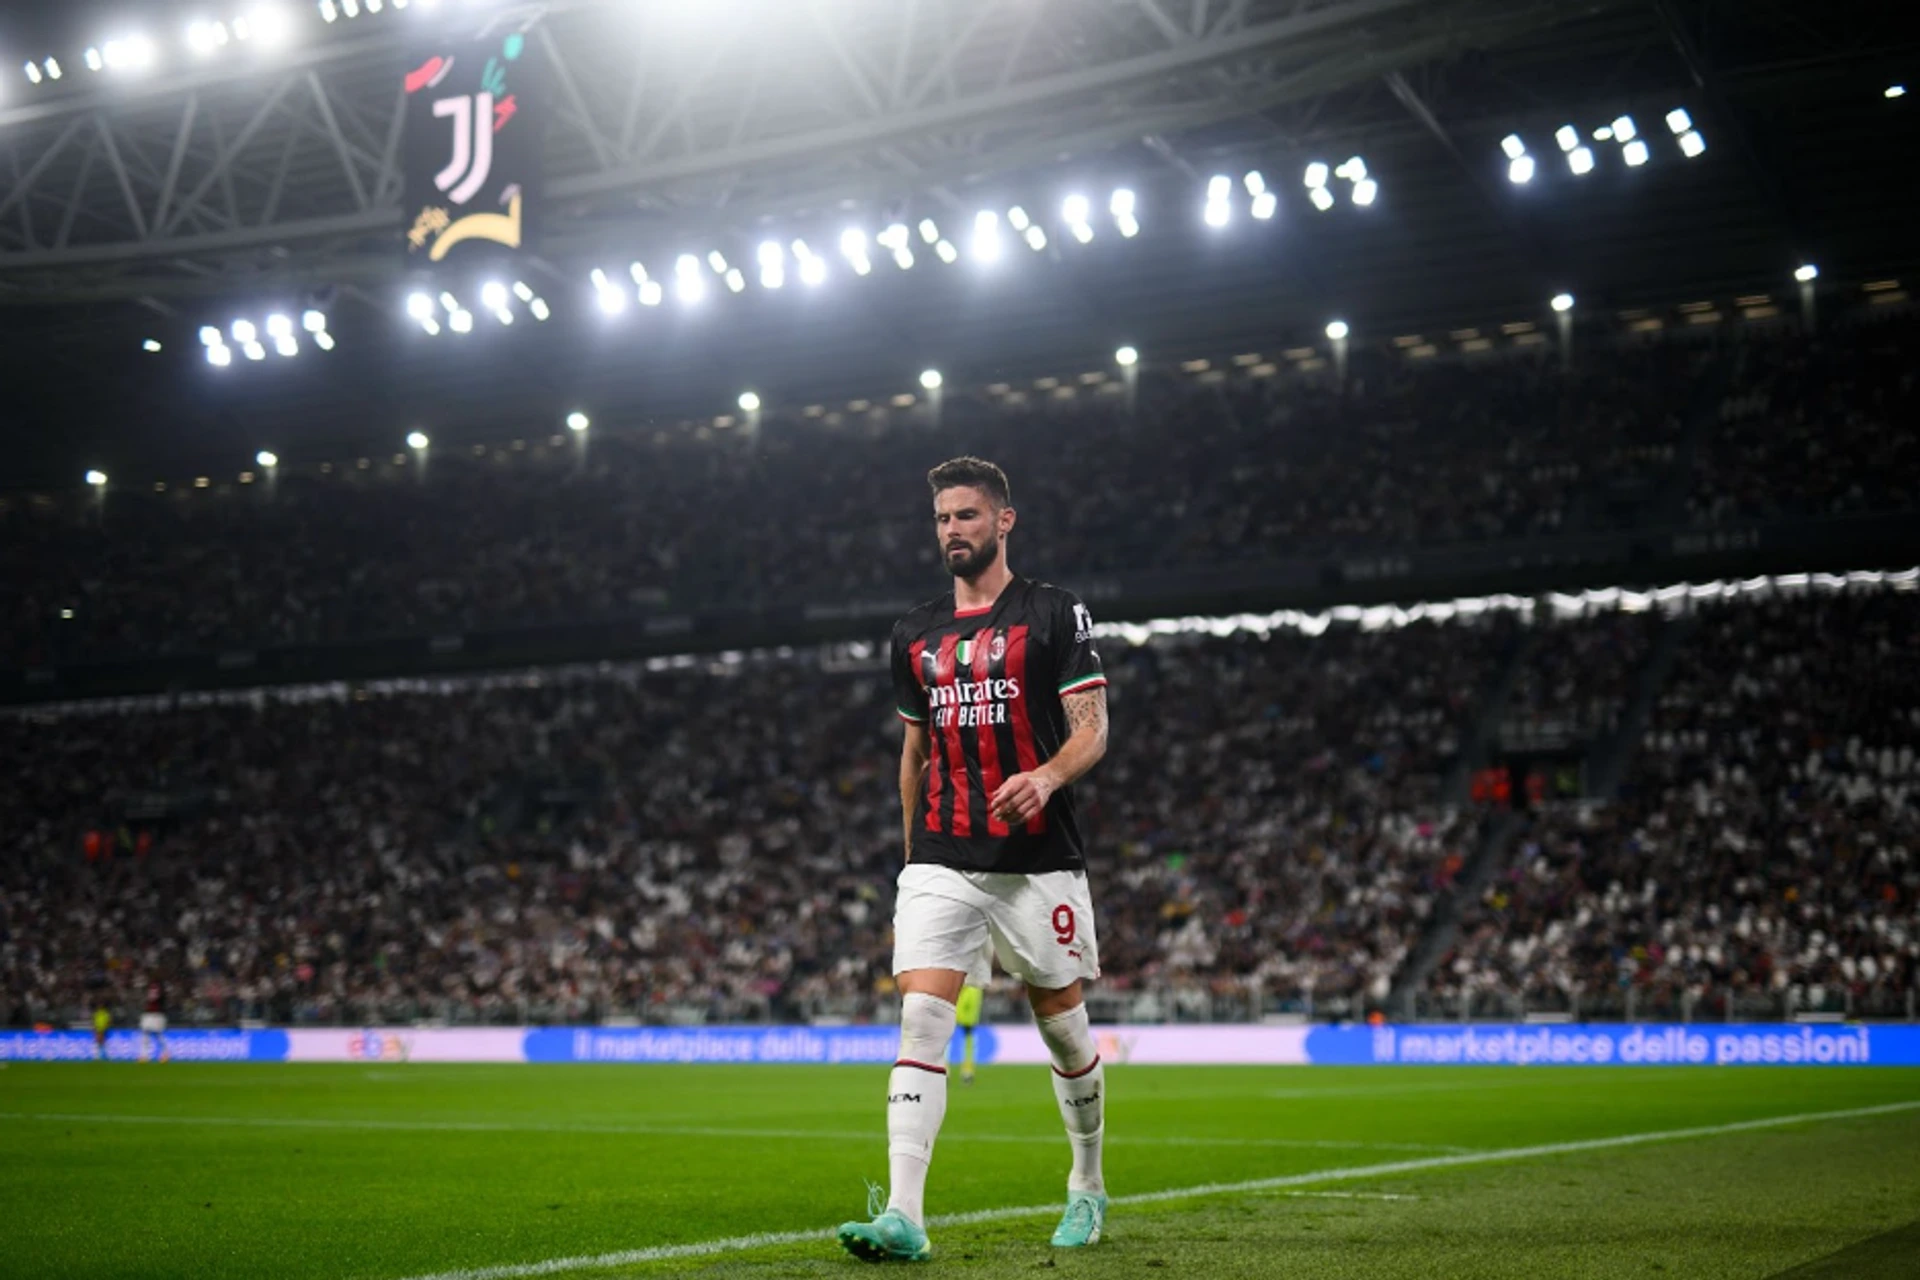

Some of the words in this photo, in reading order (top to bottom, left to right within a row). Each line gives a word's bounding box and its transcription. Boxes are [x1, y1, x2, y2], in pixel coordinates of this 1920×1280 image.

[929, 677, 1020, 707] mirates
[958, 703, 1005, 727] BETTER
[1052, 904, 1076, 945] 9
[595, 1029, 753, 1063] marketplace
[757, 1029, 825, 1061] delle
[828, 1029, 900, 1063] passi
[1373, 1026, 1396, 1062] il
[1401, 1026, 1614, 1065] marketplace
[1618, 1026, 1709, 1062] delle
[1716, 1026, 1869, 1065] passioni
